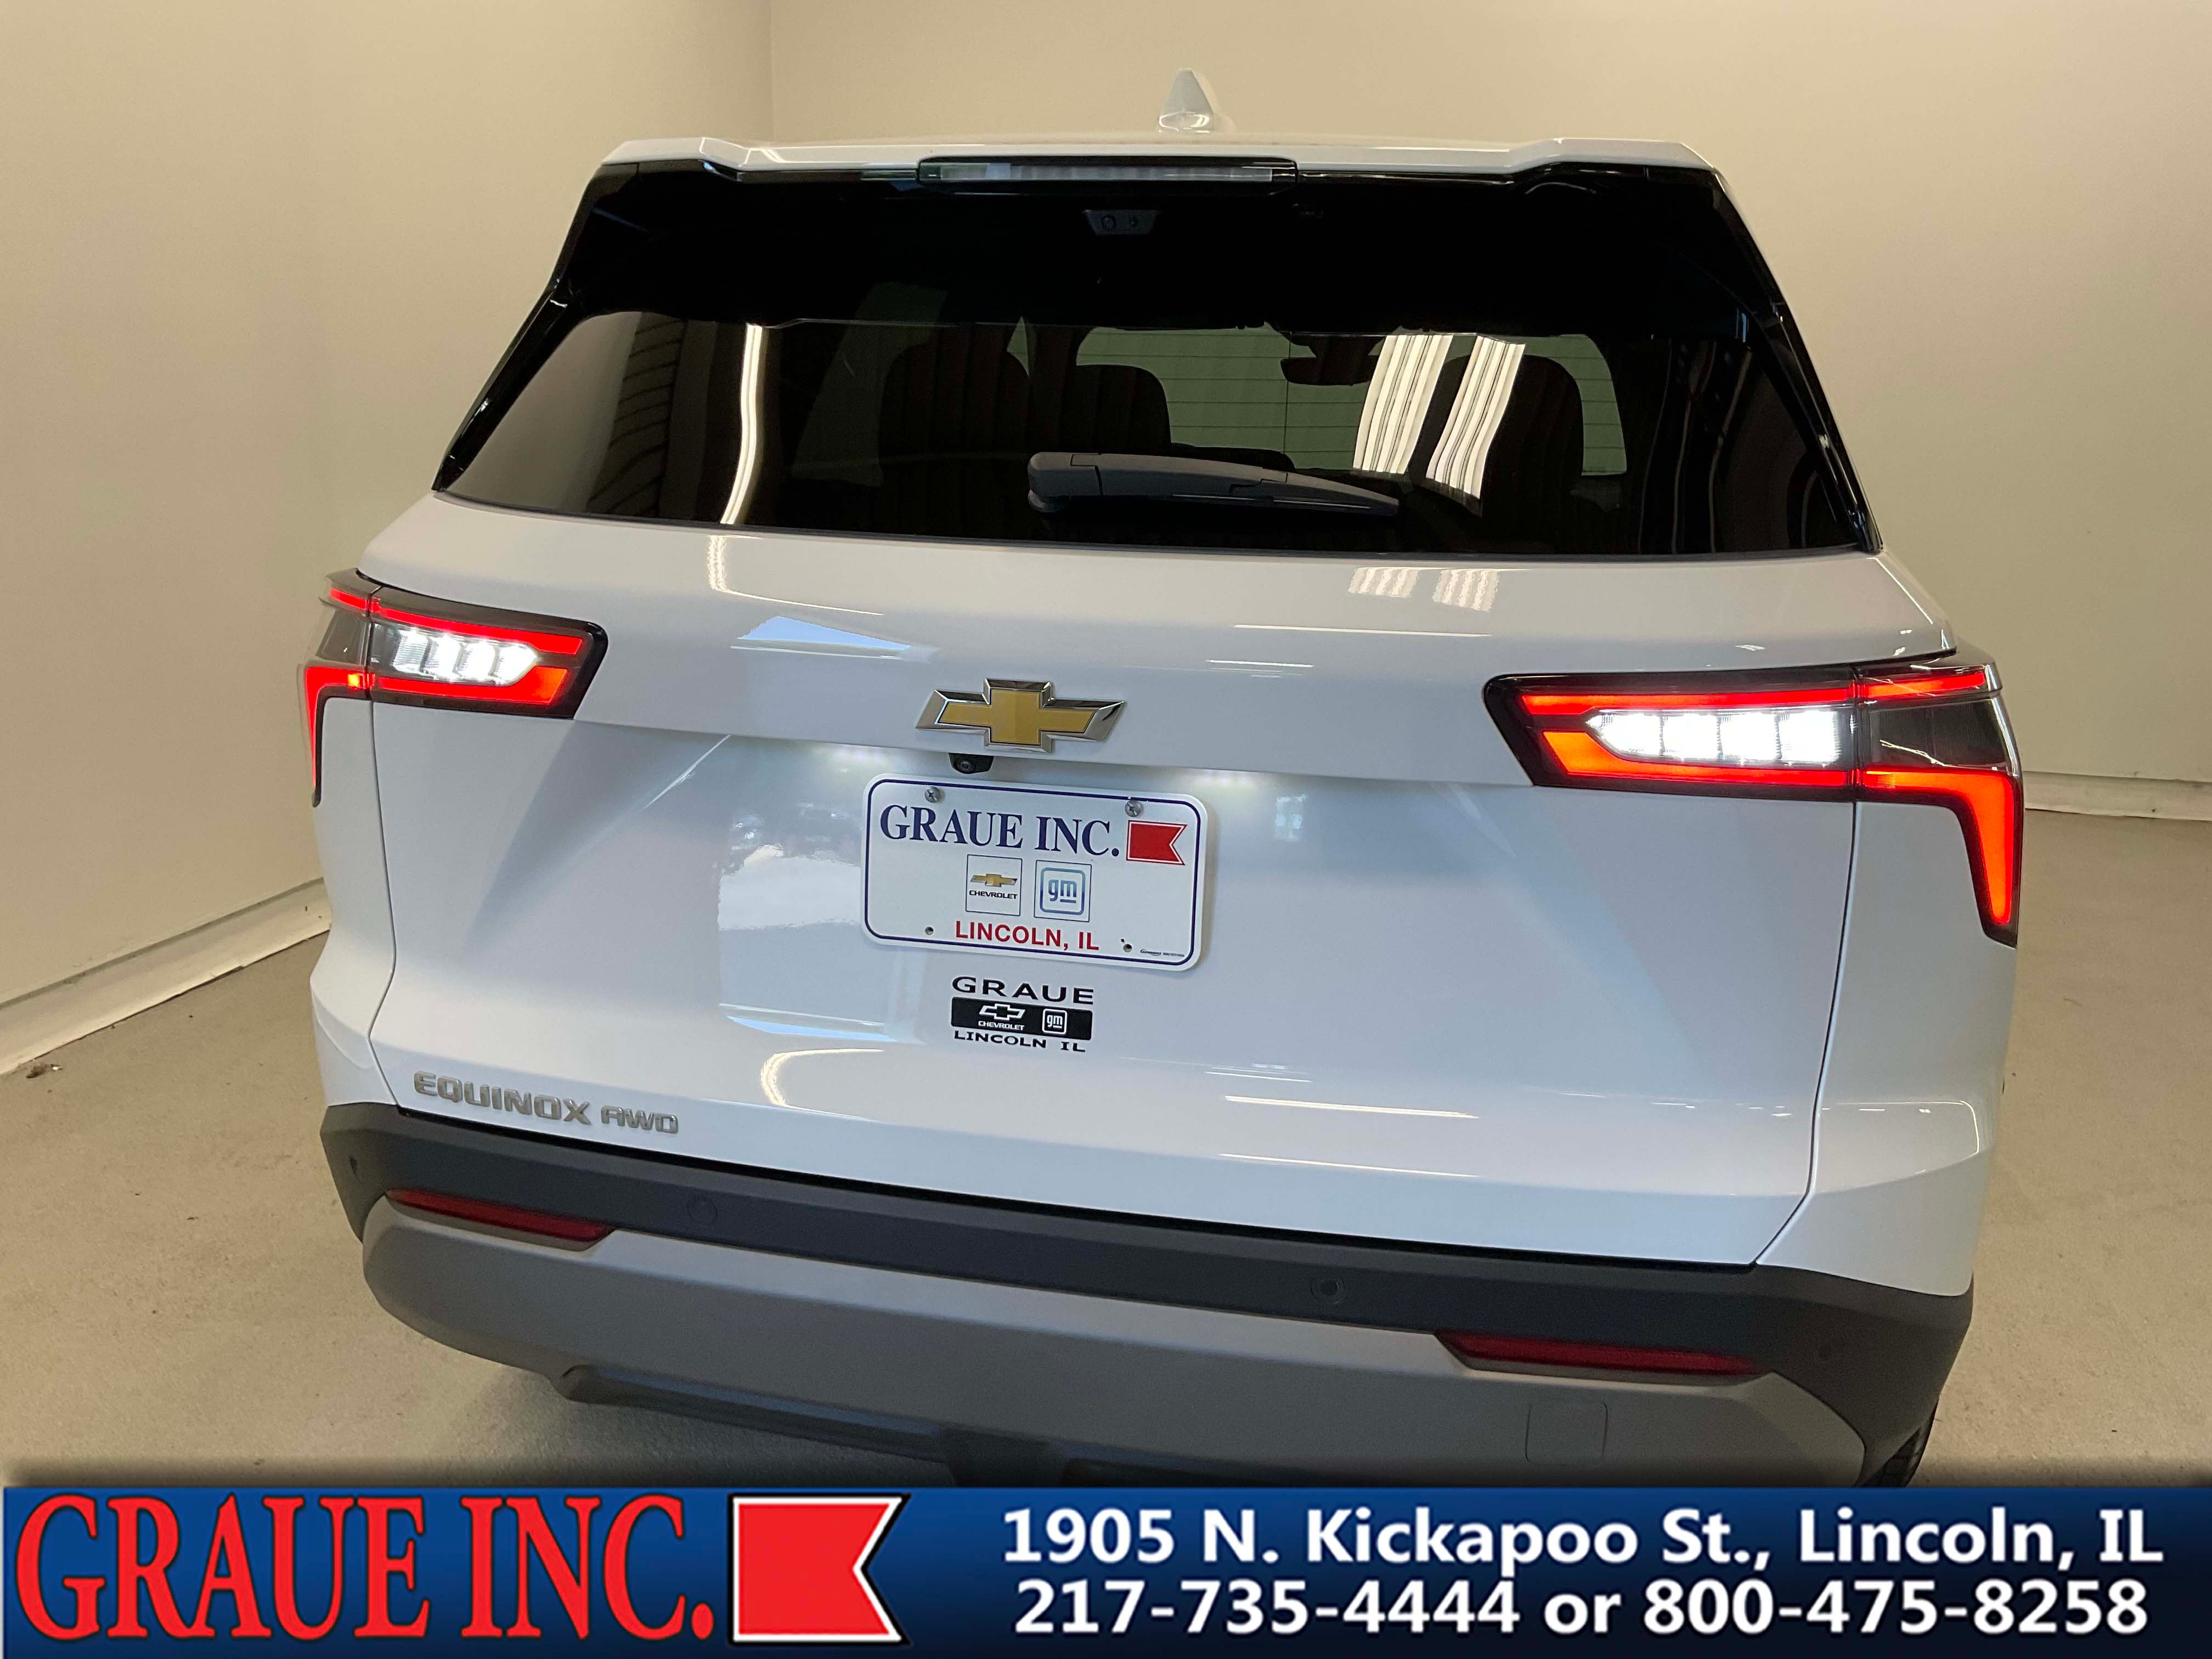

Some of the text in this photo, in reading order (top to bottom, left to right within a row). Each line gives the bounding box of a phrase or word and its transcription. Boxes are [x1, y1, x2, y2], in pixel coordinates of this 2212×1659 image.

[879, 804, 1120, 858] GRAUE INC.
[969, 889, 1018, 900] CHEVROLET
[1048, 881, 1077, 904] gm
[955, 920, 1099, 951] LINCOLN, IL
[952, 976, 1093, 1005] GRAUE
[978, 1020, 1025, 1031] CHEVROLET
[1047, 1014, 1063, 1029] gm
[954, 1030, 1086, 1053] LINCOLN IL
[414, 1071, 678, 1134] EQUINOX AWD
